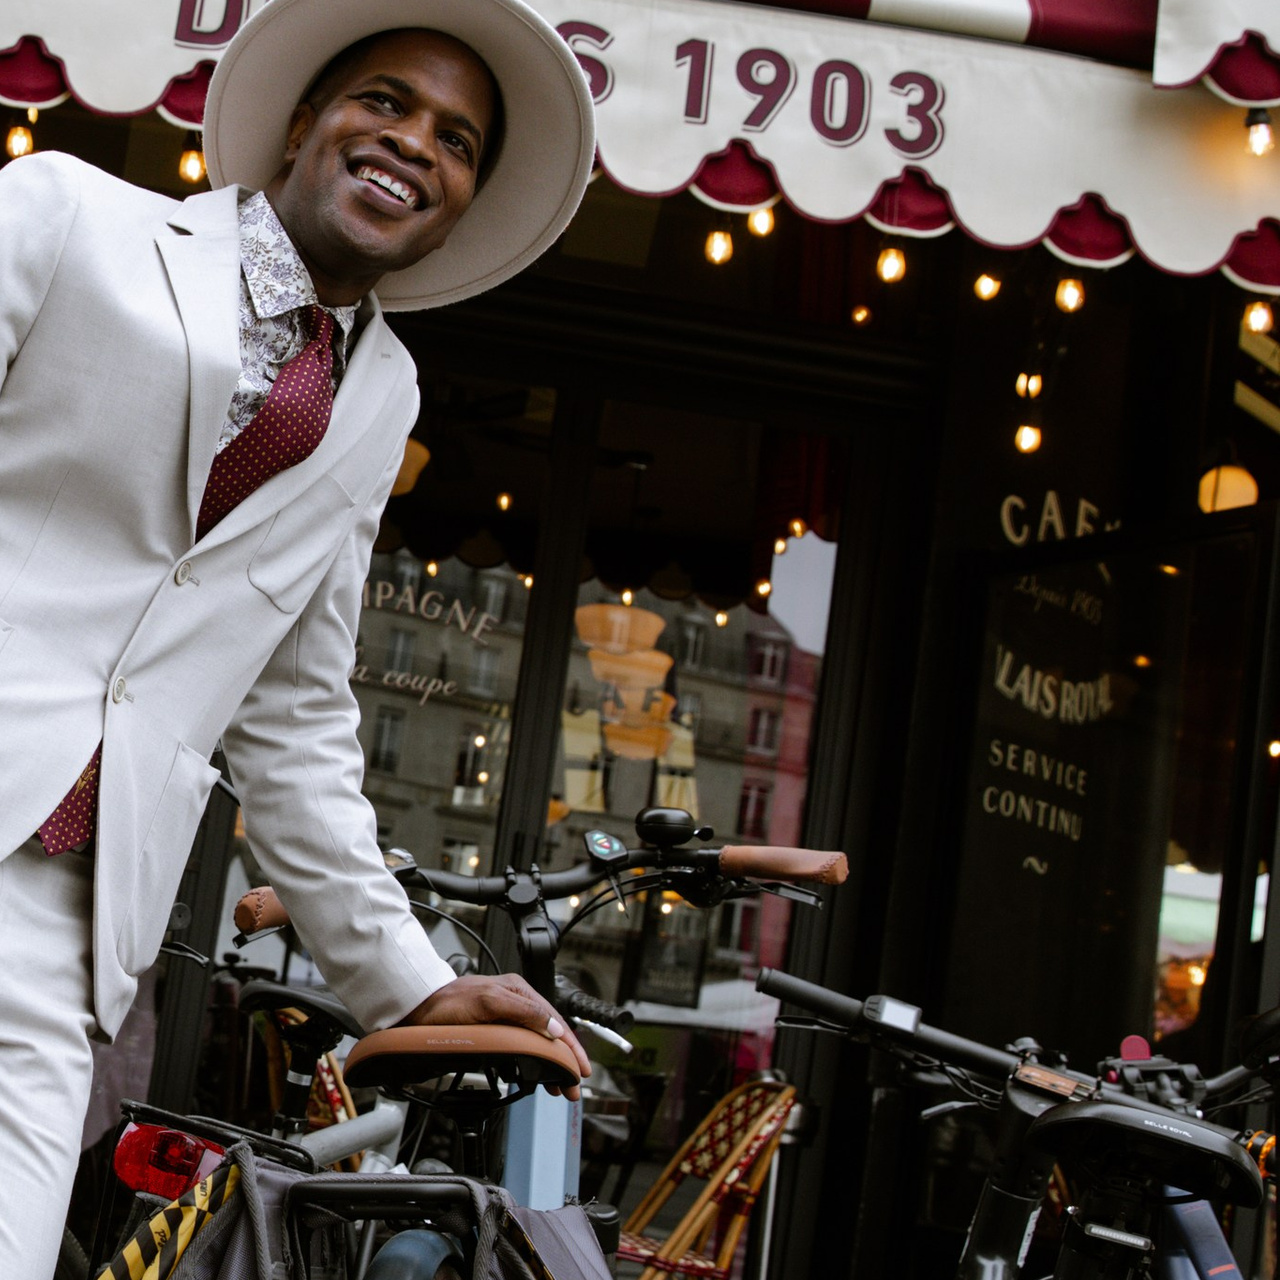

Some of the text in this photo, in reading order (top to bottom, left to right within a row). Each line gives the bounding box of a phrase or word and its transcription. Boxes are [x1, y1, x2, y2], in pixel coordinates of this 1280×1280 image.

[675, 38, 945, 160] 1903
[1000, 489, 1122, 548] CAF
[362, 580, 503, 648] PAGNE
[382, 671, 460, 710] coupe
[988, 738, 1088, 797] SERVICE
[982, 785, 1084, 843] CONTINU
[1144, 1119, 1168, 1131] SELLE
